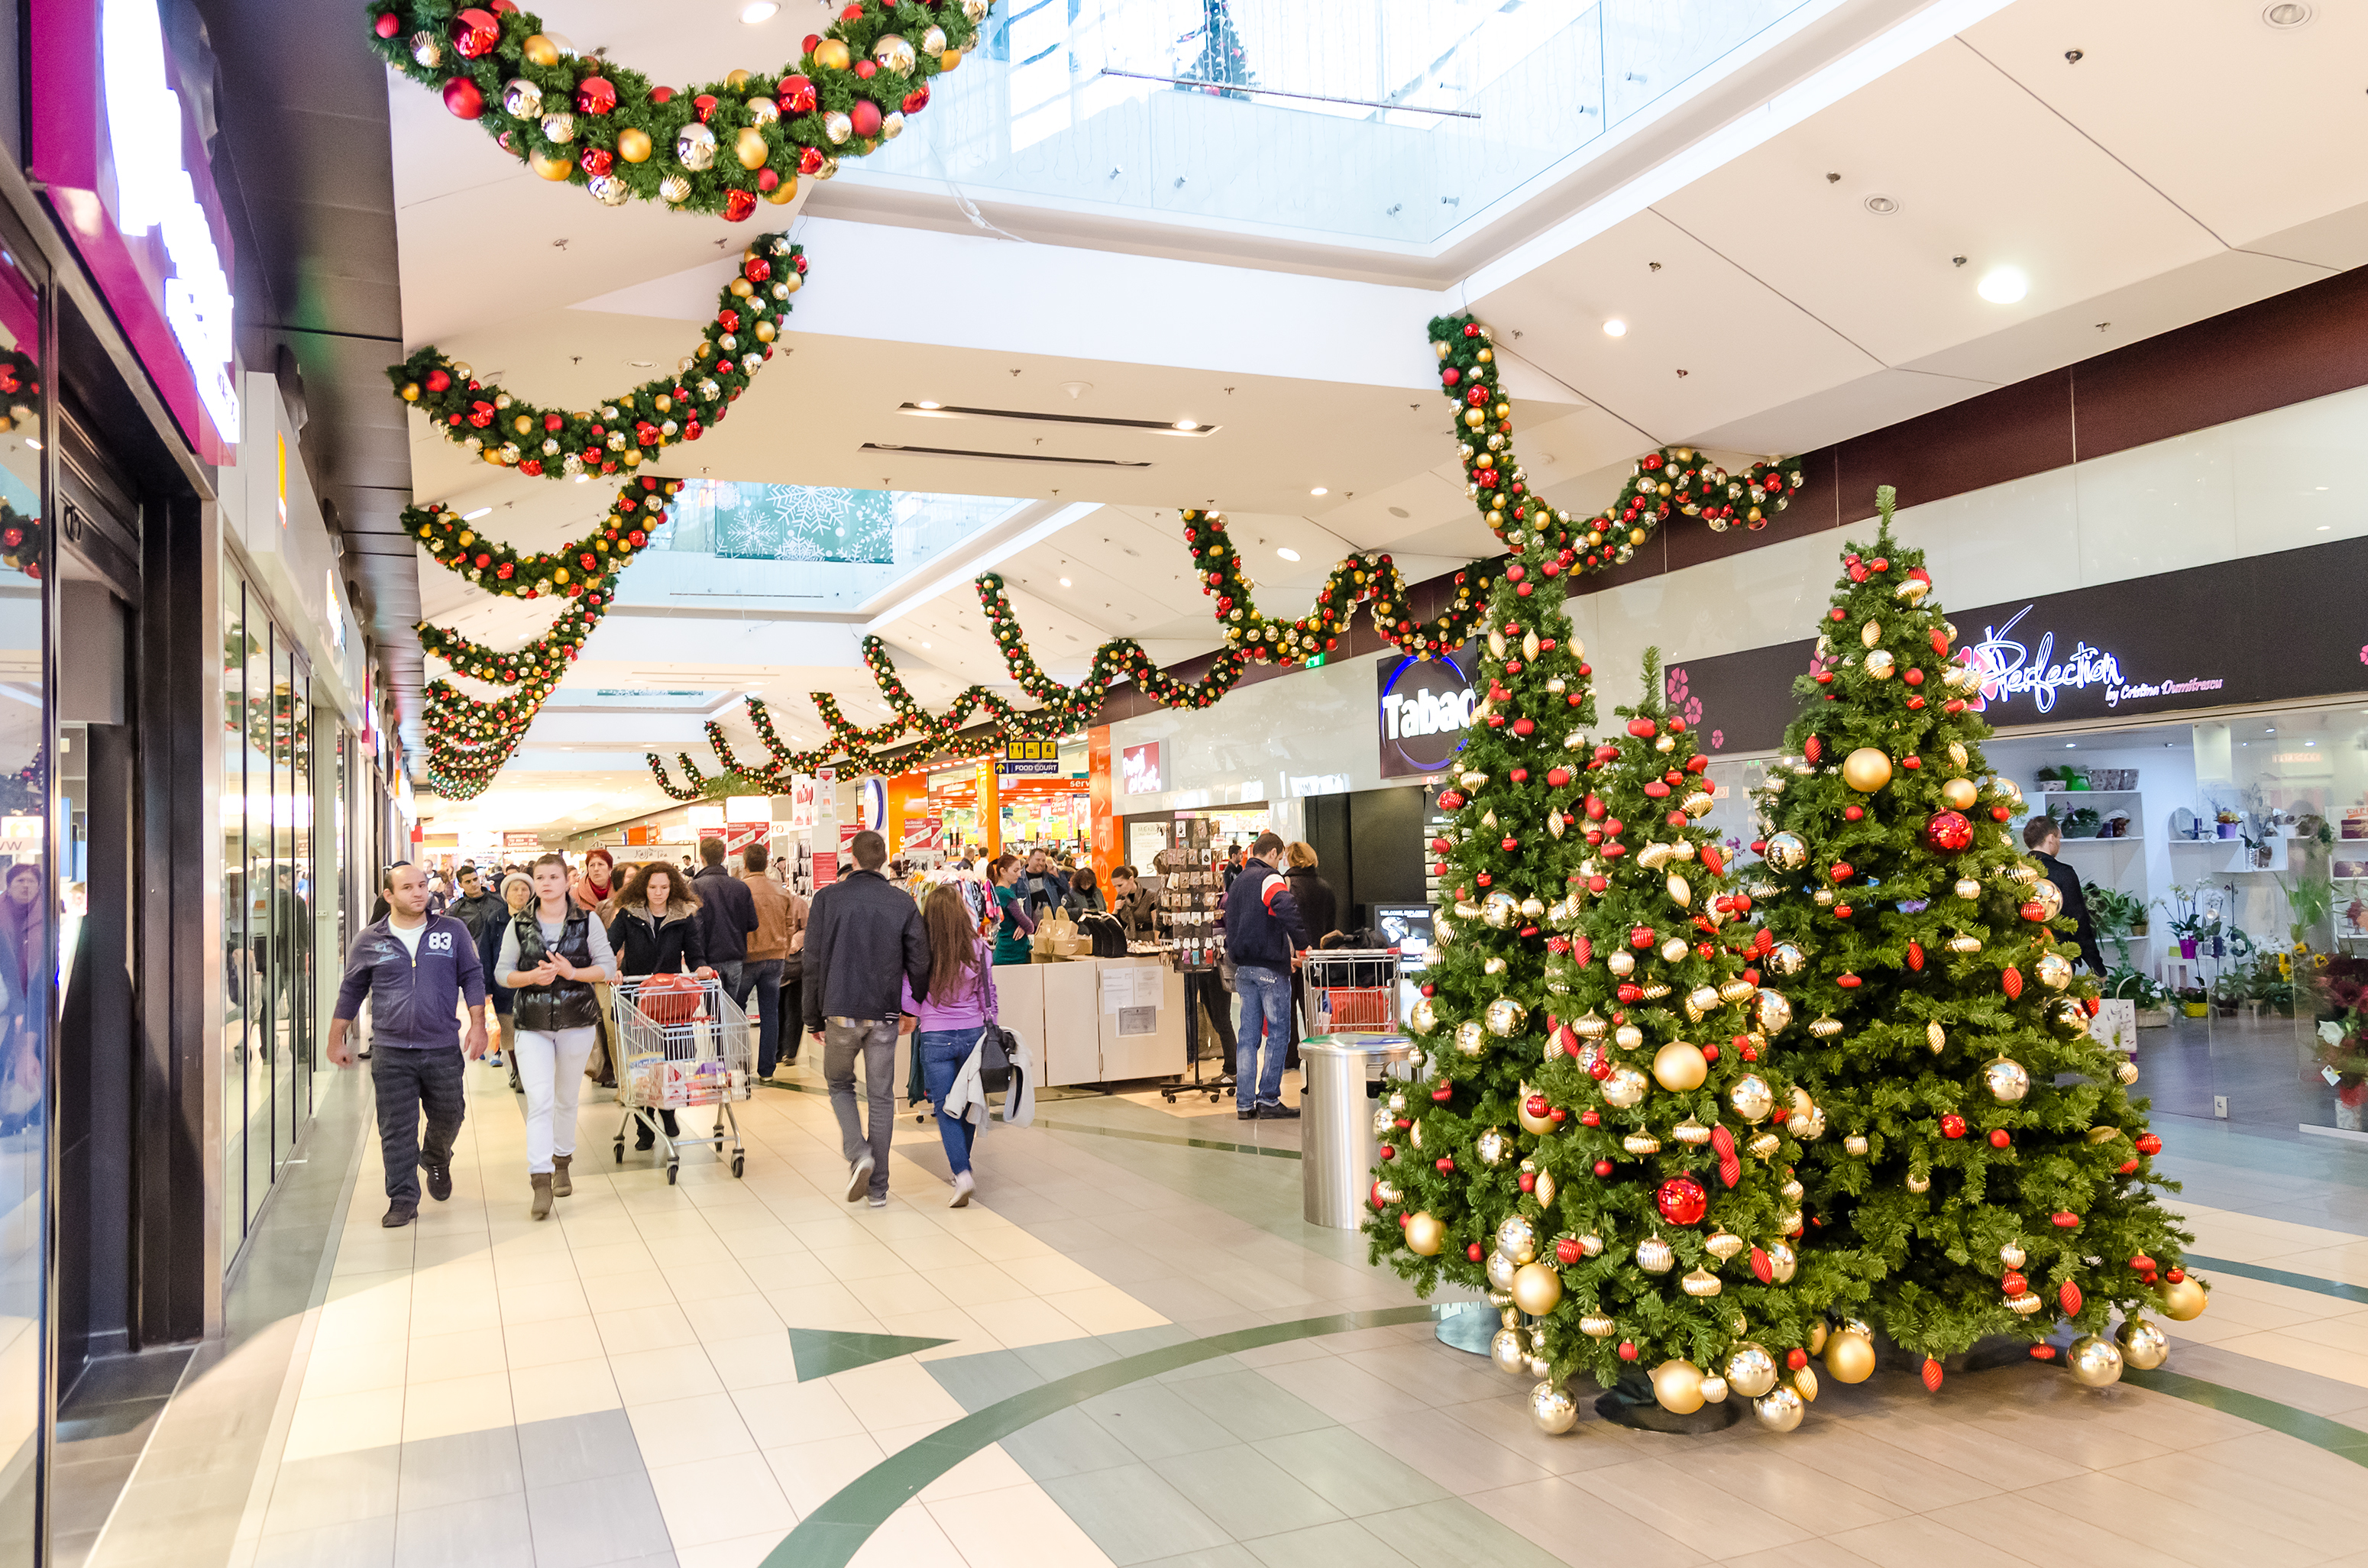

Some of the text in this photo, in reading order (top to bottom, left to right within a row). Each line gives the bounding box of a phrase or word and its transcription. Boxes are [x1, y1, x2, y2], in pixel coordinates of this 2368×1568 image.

[1973, 604, 2127, 714] Perfection
[2104, 677, 2224, 708] by Cristina Dumitrescu
[428, 932, 452, 951] 83
